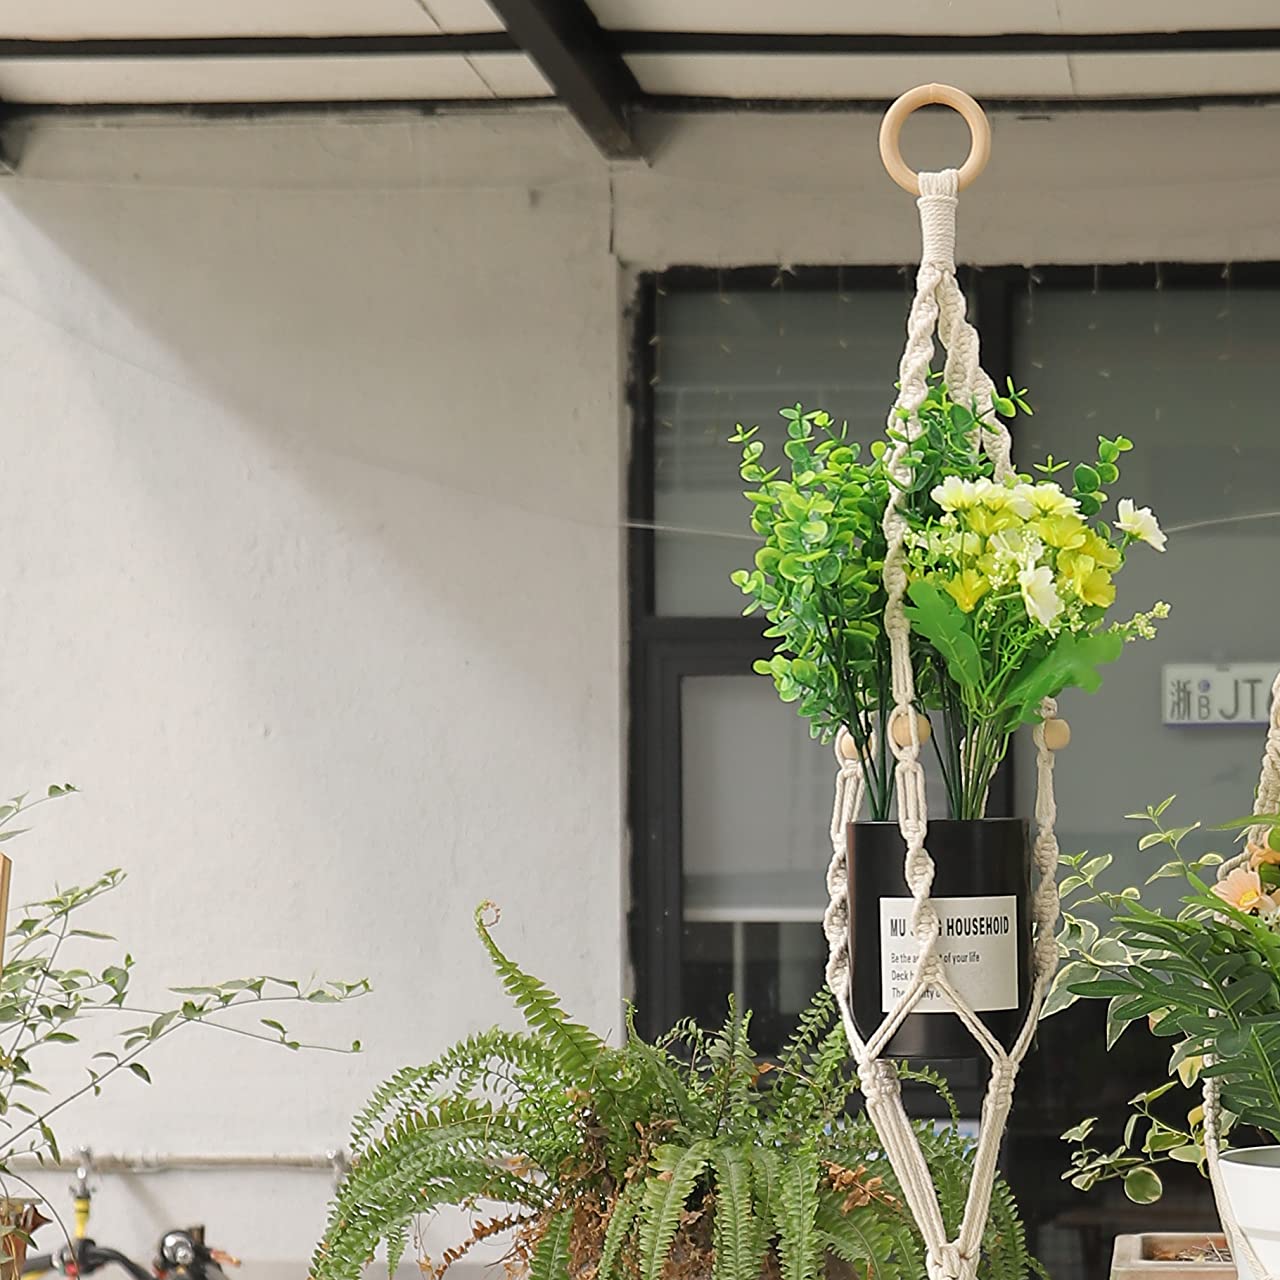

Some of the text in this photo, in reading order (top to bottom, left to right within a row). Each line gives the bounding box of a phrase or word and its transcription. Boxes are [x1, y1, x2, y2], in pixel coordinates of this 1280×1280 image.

[900, 953, 911, 963] the
[943, 952, 951, 963] of
[952, 953, 968, 965] your
[969, 951, 980, 963] life
[891, 969, 908, 982] Deck
